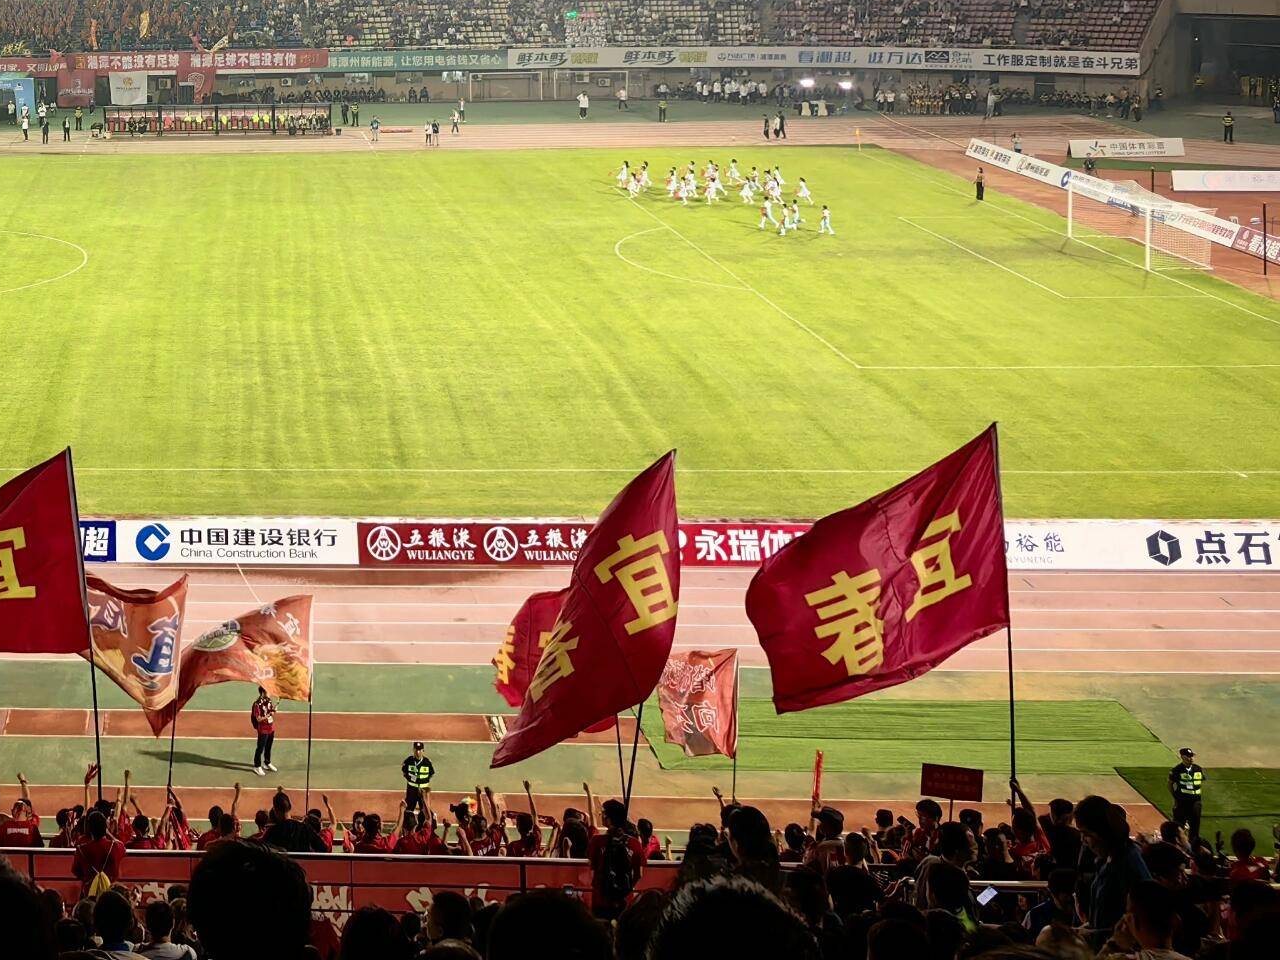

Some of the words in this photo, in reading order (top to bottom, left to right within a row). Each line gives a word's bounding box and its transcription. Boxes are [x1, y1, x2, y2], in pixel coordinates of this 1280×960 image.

[982, 53, 1139, 70] 工作服定制就是奋斗兄弟
[180, 527, 338, 547] 中国建设银行
[402, 527, 477, 549] 五粮液
[694, 529, 810, 561] 永瑞体
[180, 547, 213, 558] China
[216, 547, 286, 559] Construction
[289, 548, 318, 559] Bank
[406, 549, 475, 560] WULIANGYE
[524, 550, 581, 561] WULIANG
